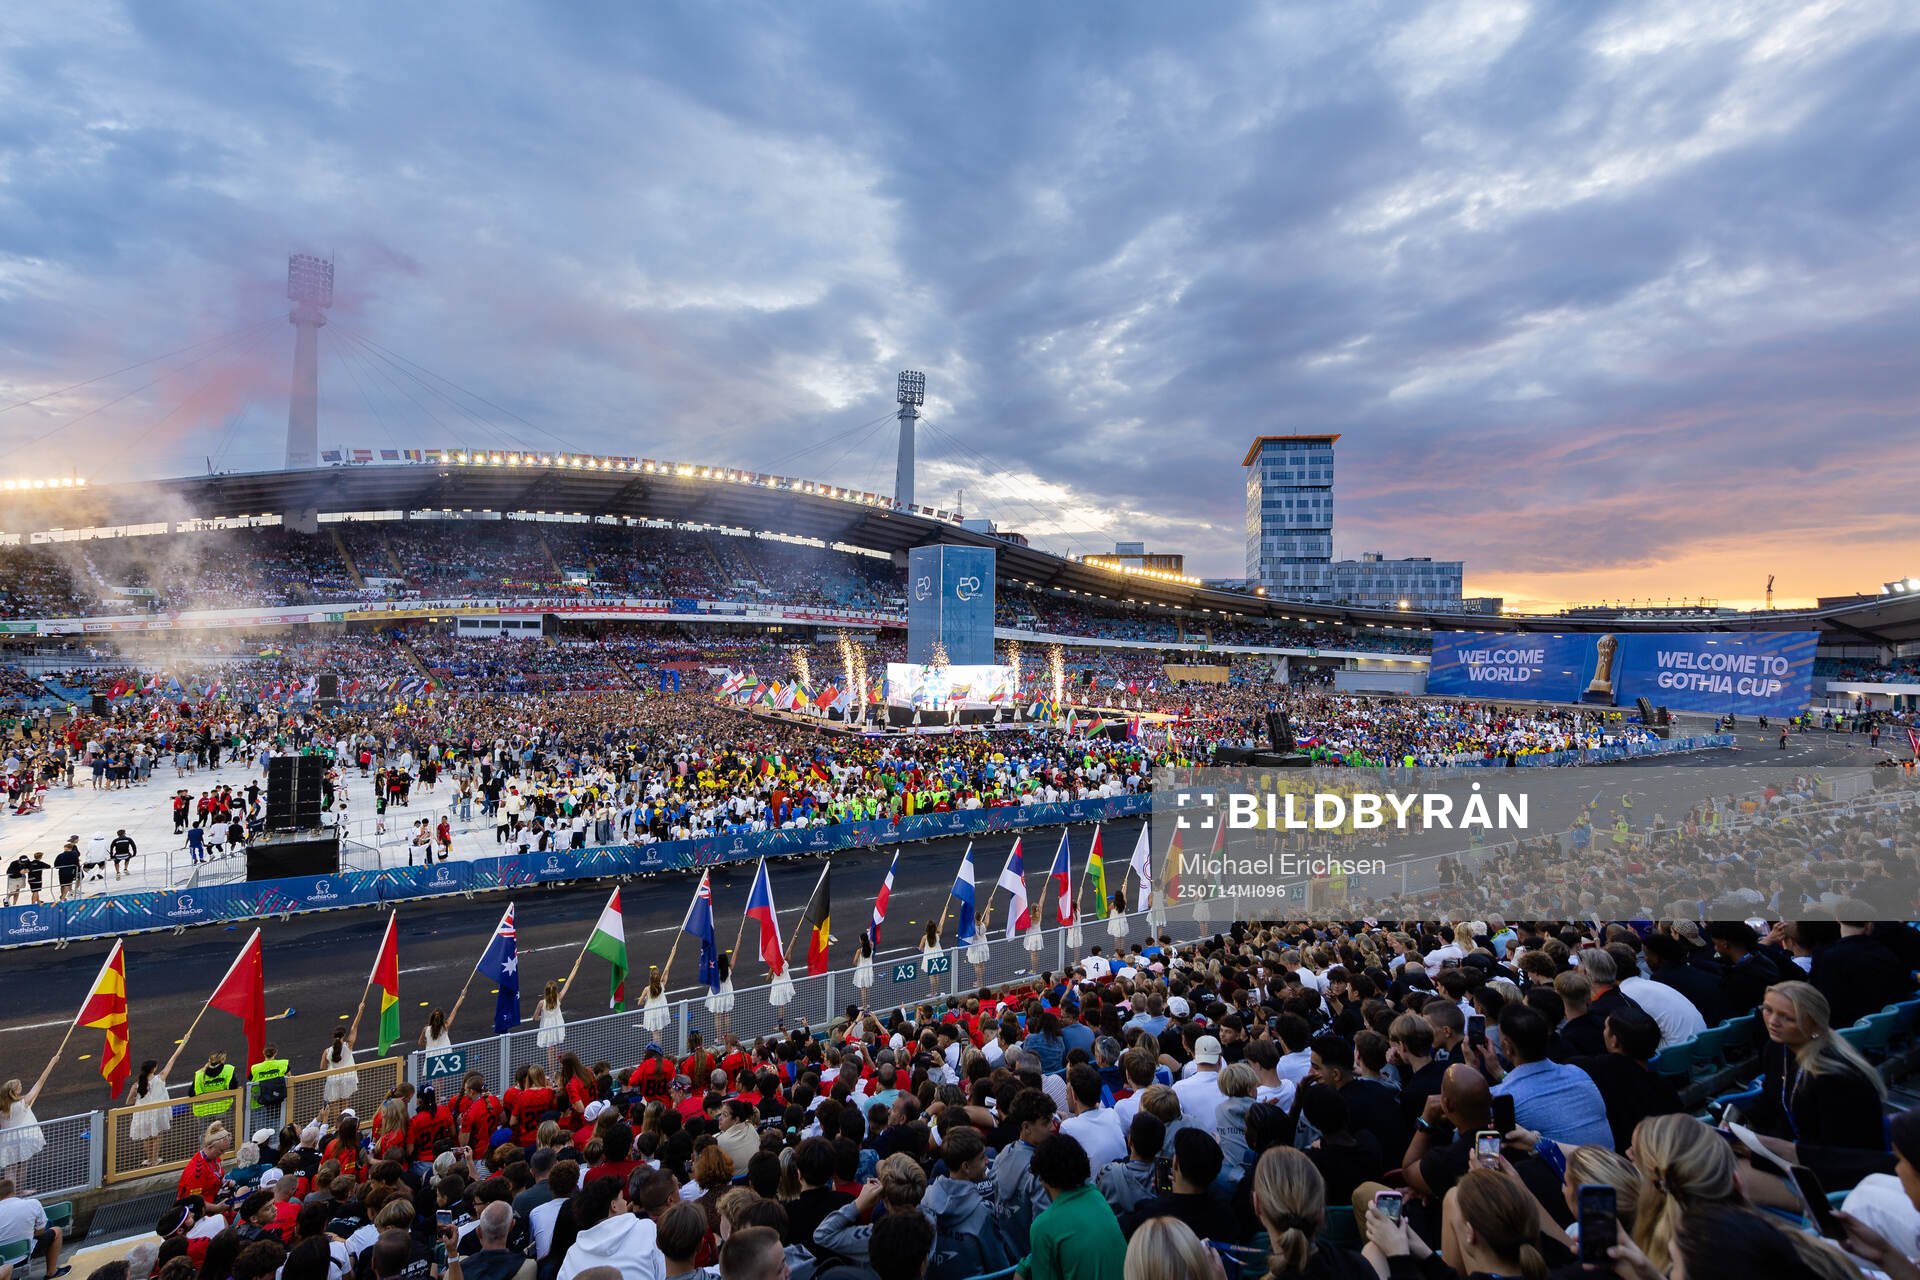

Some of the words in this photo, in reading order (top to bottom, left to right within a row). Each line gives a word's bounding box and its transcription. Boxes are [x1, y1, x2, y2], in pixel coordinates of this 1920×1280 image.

[1458, 650, 1544, 664] WELCOME
[1657, 651, 1756, 673] WELCOME
[1761, 656, 1788, 676] TO
[1469, 667, 1531, 681] WORLD
[1658, 672, 1732, 694] GOTHIA
[1737, 677, 1782, 697] CUP
[8, 926, 33, 935] Gothia
[33, 925, 49, 933] Cup
[896, 965, 915, 980] Ä3
[930, 959, 948, 973] Ä2
[1093, 962, 1100, 972] 4
[431, 1055, 462, 1076] Ä3
